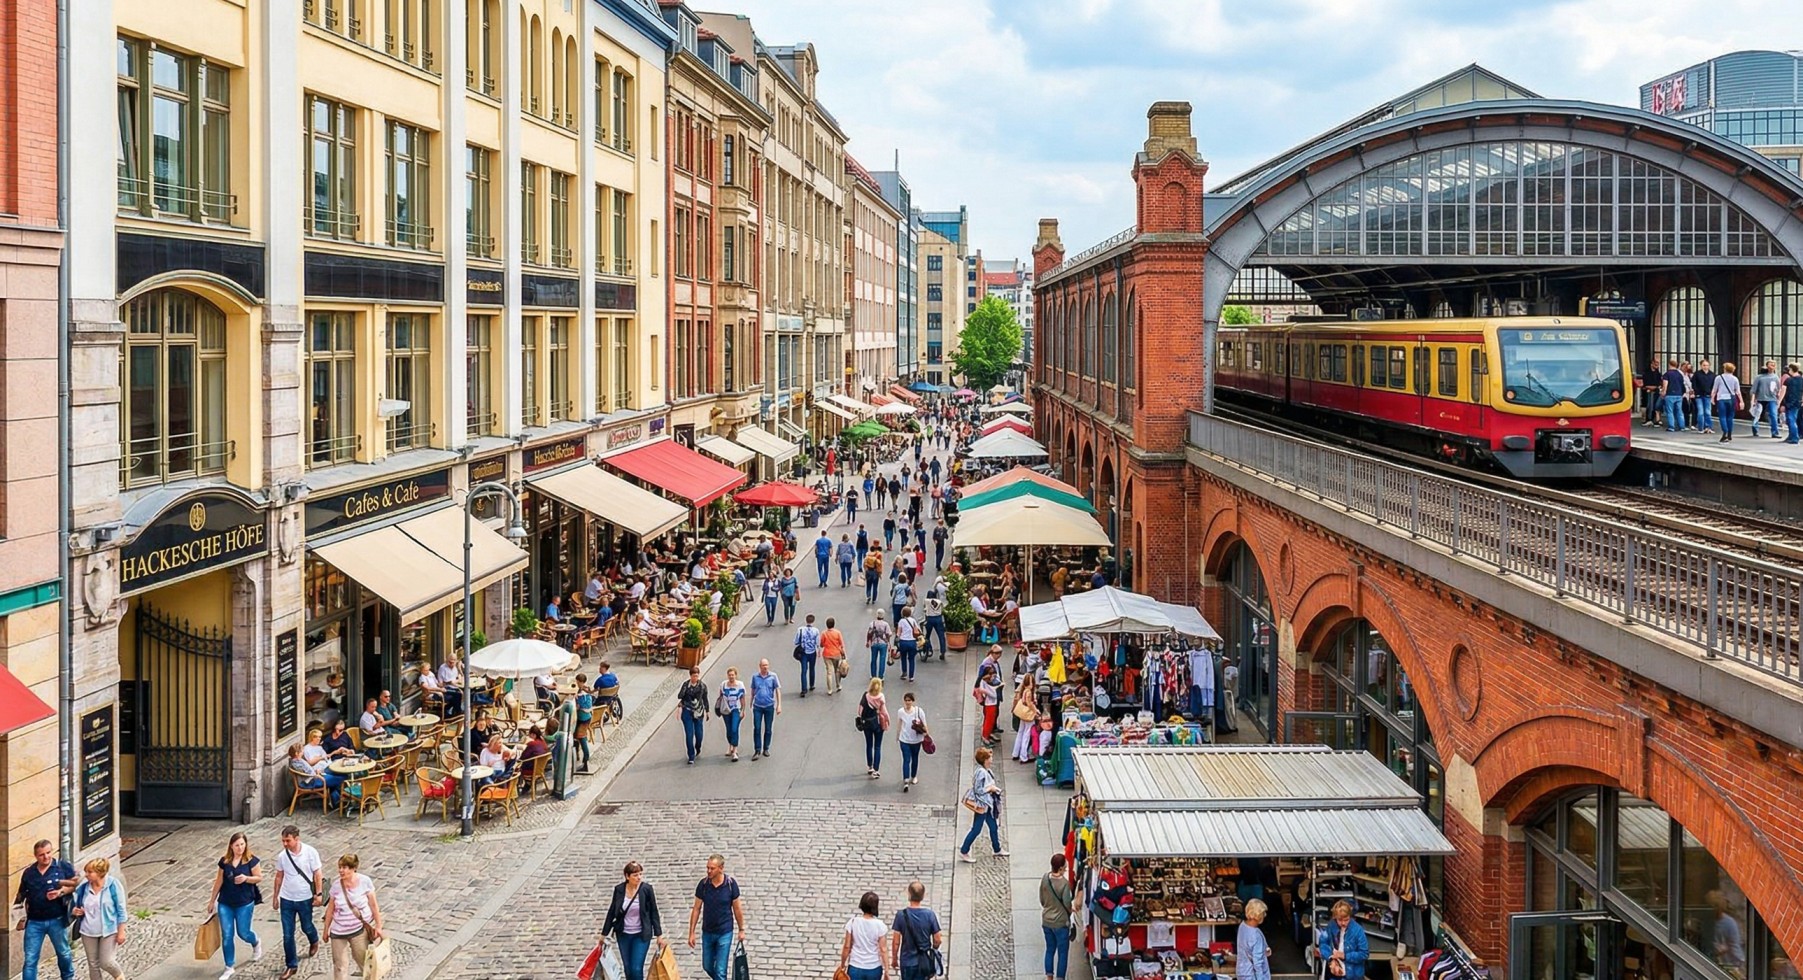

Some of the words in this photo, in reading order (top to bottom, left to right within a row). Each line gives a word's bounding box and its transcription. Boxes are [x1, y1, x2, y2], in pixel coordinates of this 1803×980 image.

[345, 492, 379, 518] Cafes
[381, 487, 392, 508] &
[122, 534, 222, 583] HACKESCHE
[226, 524, 264, 553] HÖFE
